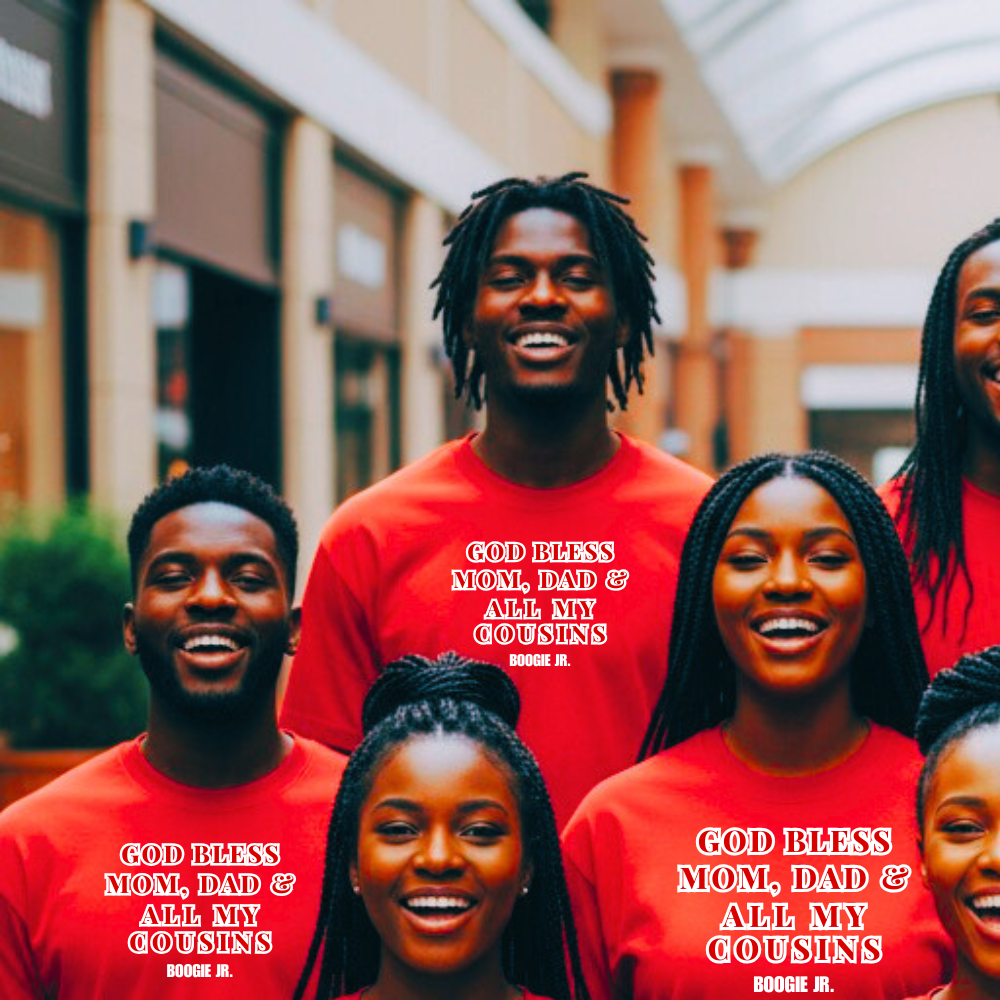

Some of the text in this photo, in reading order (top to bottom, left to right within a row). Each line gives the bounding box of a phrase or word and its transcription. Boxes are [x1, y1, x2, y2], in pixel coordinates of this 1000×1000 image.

[465, 540, 616, 564] GOD BLESS
[451, 568, 630, 595] MOM, DAD &
[483, 597, 597, 621] ALL MY
[472, 622, 608, 646] COUSINS
[509, 653, 571, 667] BOOGIE JR.
[695, 826, 893, 857] GOD BLESS
[119, 842, 281, 867] GOD BLESS
[103, 872, 297, 900] MOM, DAD &
[676, 863, 913, 898] MOM, DAD &
[138, 903, 261, 928] ALL MY
[719, 901, 869, 931] ALL MY
[127, 930, 273, 955] COUSINS
[705, 934, 883, 965] COUSINS
[166, 963, 233, 978] BOOGIE JR.
[753, 975, 835, 993] BOOGIE JR.
